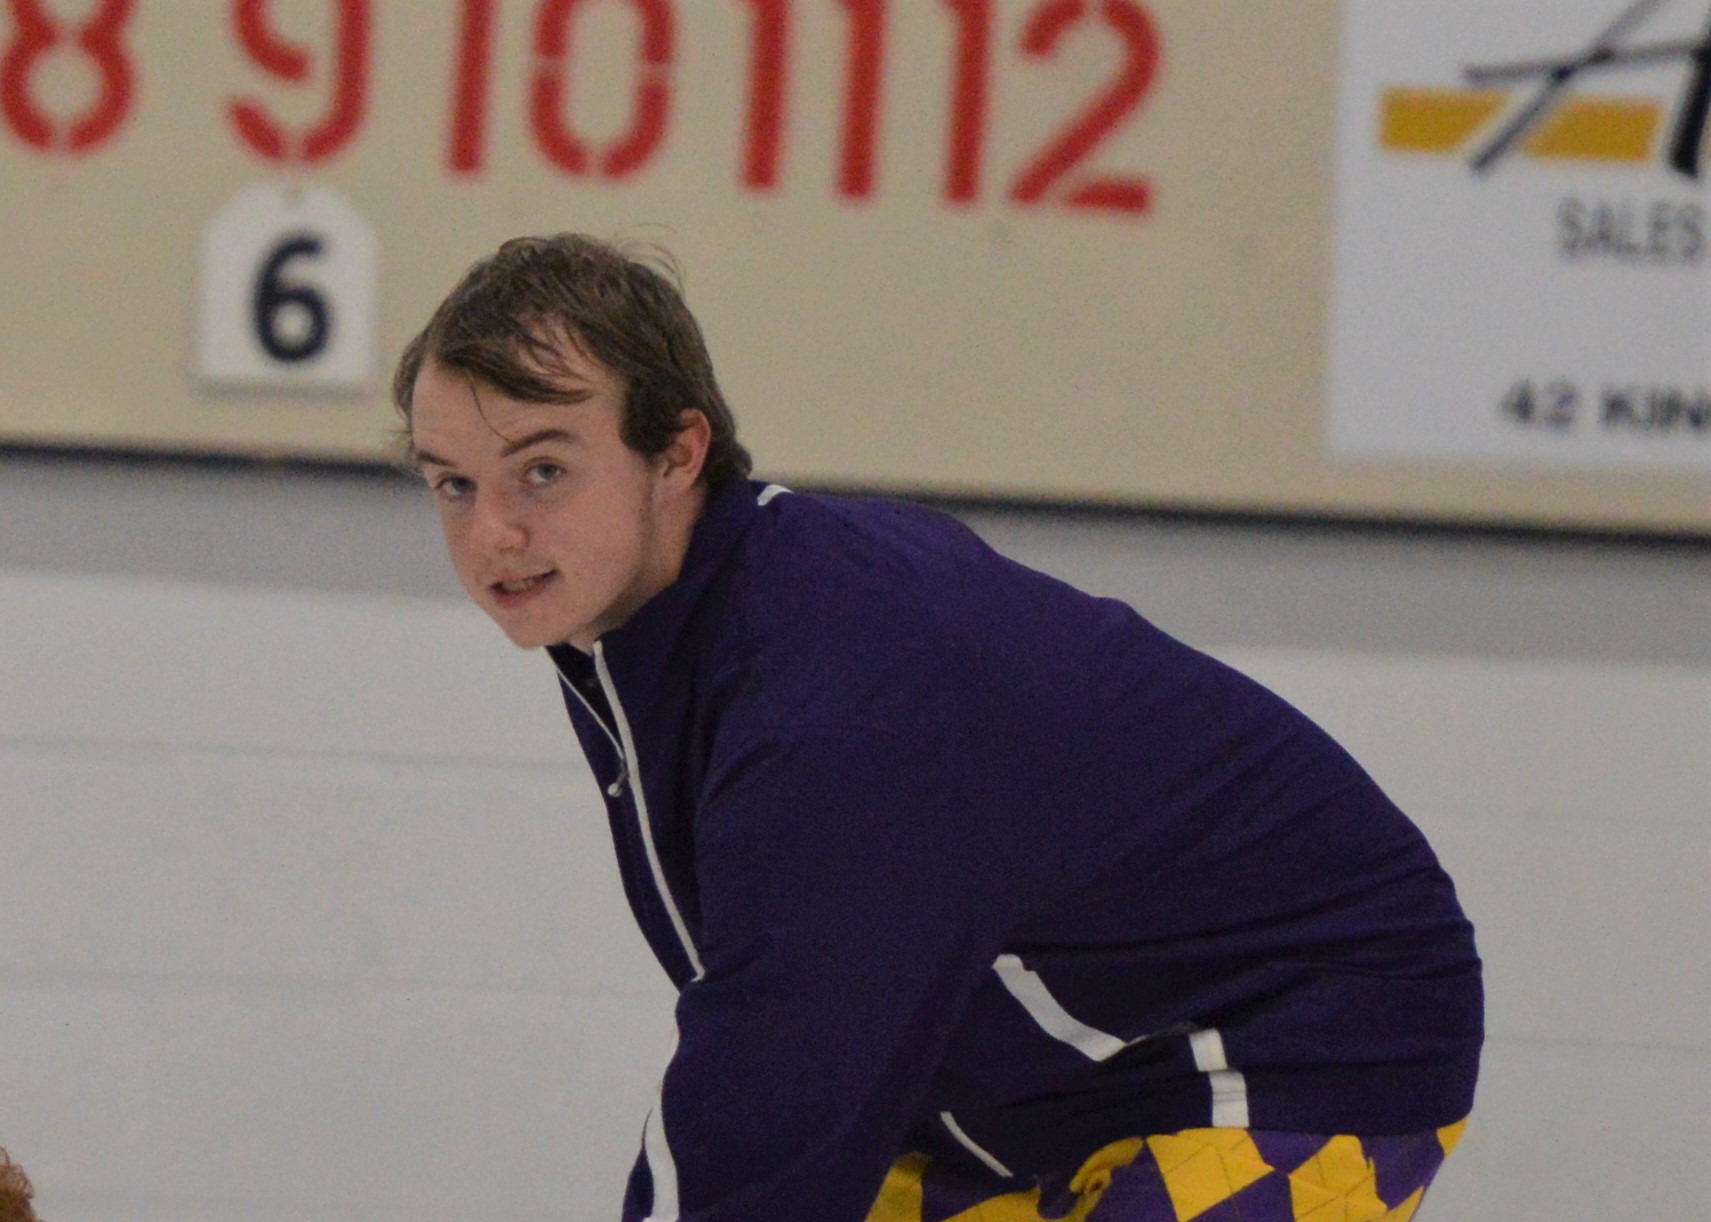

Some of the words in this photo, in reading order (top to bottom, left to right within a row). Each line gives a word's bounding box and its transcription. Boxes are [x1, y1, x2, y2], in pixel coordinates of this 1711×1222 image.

[228, 0, 372, 166] 9
[444, 0, 677, 179] 10
[738, 0, 885, 201] 11
[940, 0, 1154, 214] 12
[251, 230, 332, 365] 6
